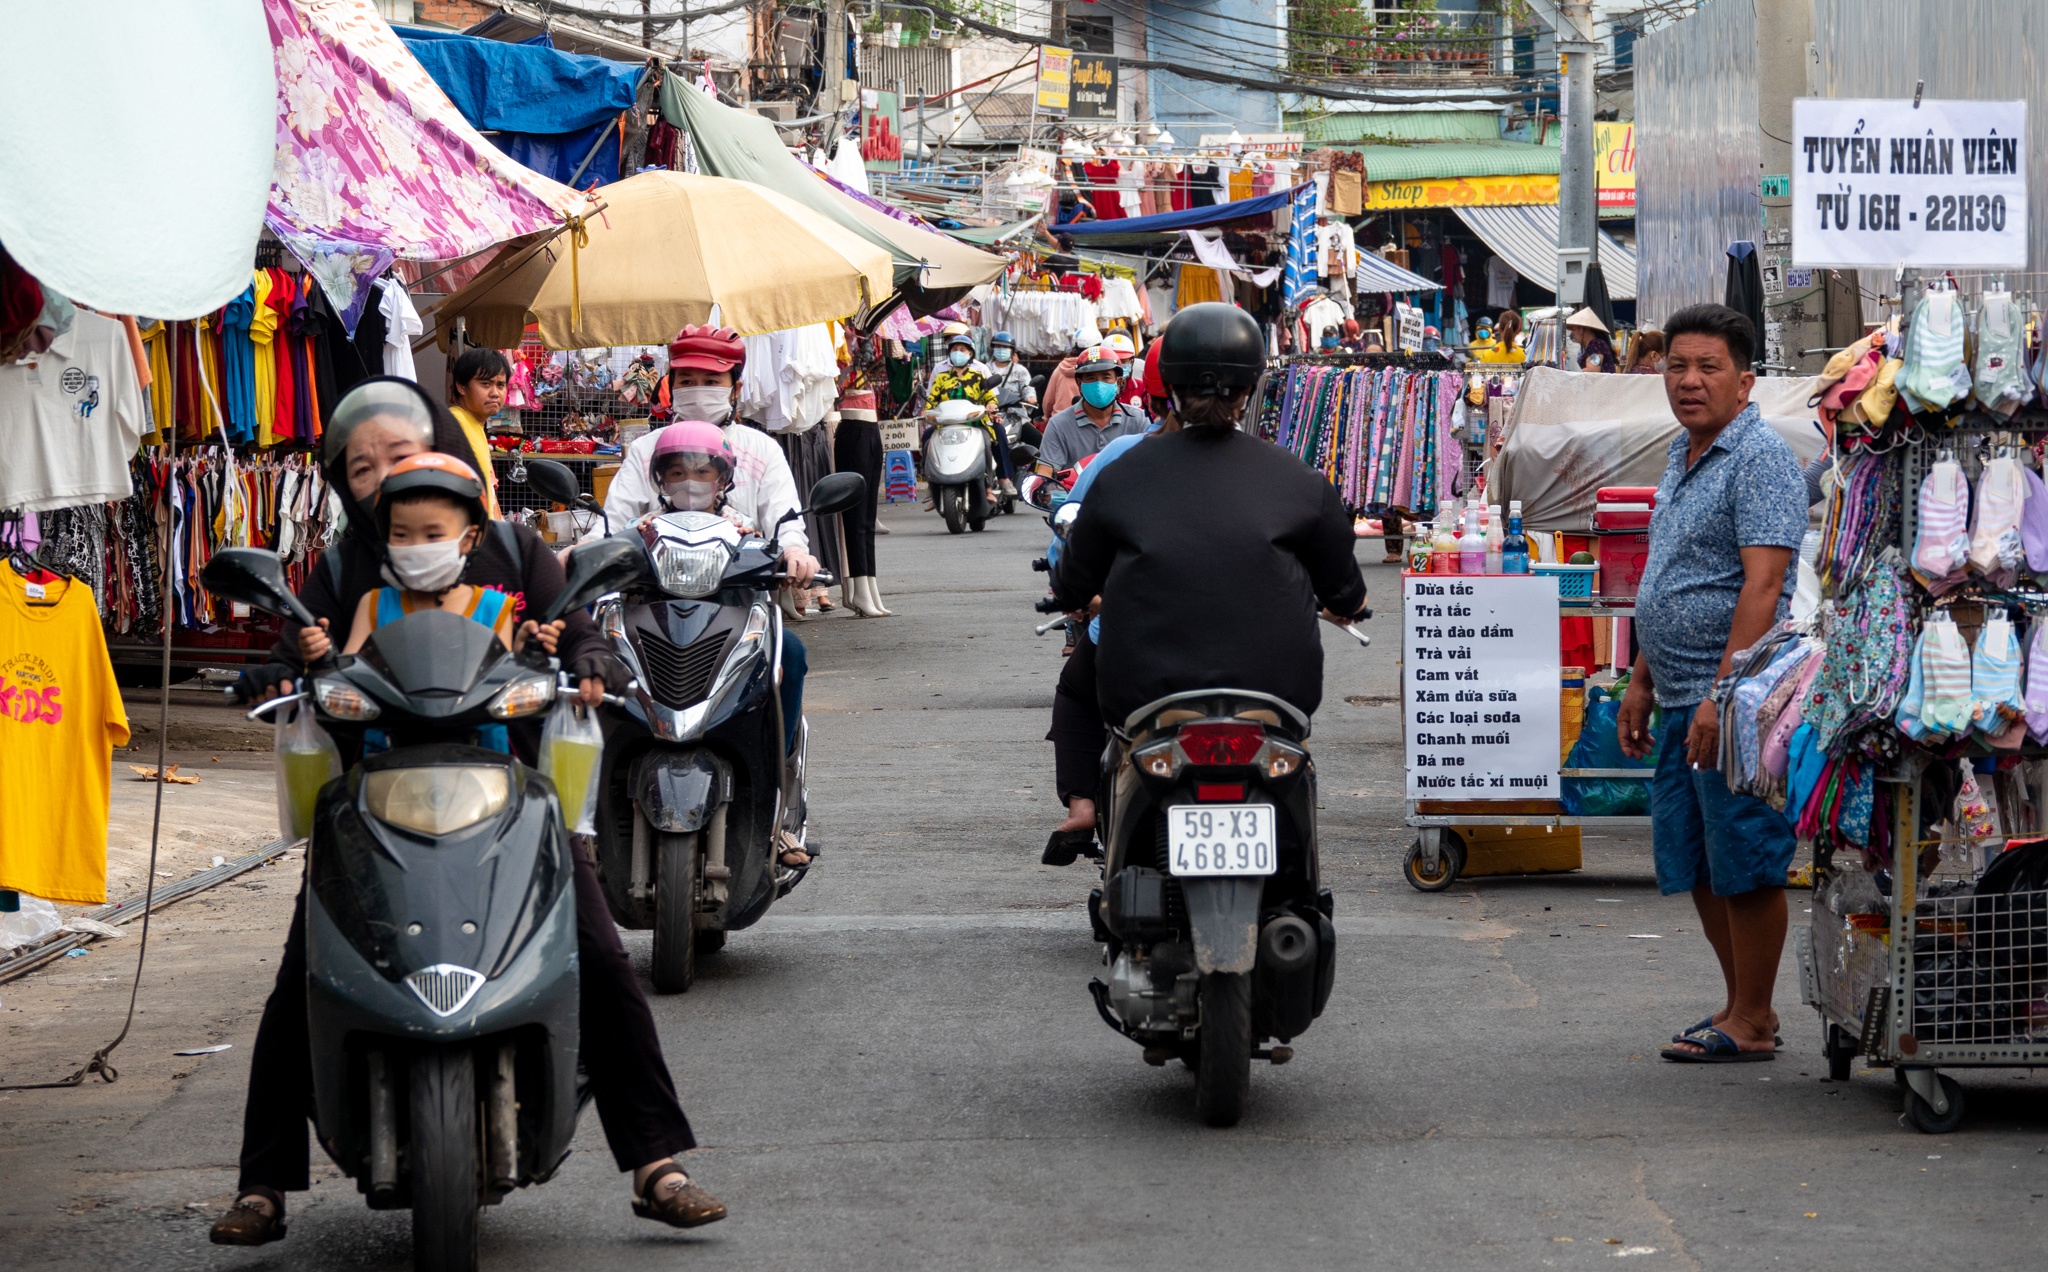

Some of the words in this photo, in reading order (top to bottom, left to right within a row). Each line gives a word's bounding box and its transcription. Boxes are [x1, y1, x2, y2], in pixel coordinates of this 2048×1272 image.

[1094, 61, 1112, 90] Shop
[1803, 118, 1881, 174] TUYỂN
[1890, 128, 1954, 175] NHÂN
[1962, 128, 2018, 175] VIÊN
[1381, 181, 1423, 203] Shop
[1426, 176, 1476, 203] ĐỒ
[1484, 184, 1556, 203] NAM
[1817, 183, 1852, 231] TỪ
[1859, 194, 1901, 231] 16H
[1925, 194, 2006, 232] 22H30
[905, 420, 917, 428] NỮ
[892, 431, 905, 439] ĐÔI
[1411, 554, 1429, 572] C2
[1415, 583, 1445, 596] Dừa
[1450, 581, 1474, 596] tắc
[1415, 604, 1442, 617] Trà
[1447, 602, 1471, 617] tắc
[1415, 626, 1442, 638] Trà
[1447, 625, 1475, 638] đào
[1416, 647, 1443, 660] Trà
[1447, 645, 1471, 660] vải
[1416, 669, 1449, 681] Cam
[1455, 666, 1479, 681] vắt
[1416, 690, 1449, 702] Xâm
[1455, 690, 1483, 702] dứa
[1488, 689, 1517, 702] sữa
[1416, 711, 1444, 724] Các
[1449, 711, 1478, 726] loại
[1483, 711, 1521, 724] sođa
[1417, 733, 1466, 745] Chanh
[1471, 730, 1510, 745] muối
[1417, 754, 1436, 767] Đá
[1442, 757, 1465, 767] me
[1417, 774, 1456, 788] Nước
[1460, 773, 1484, 788] tắc
[1489, 775, 1504, 787] xí
[1509, 775, 1548, 789] muội
[1185, 811, 1258, 839] 59-X3
[1177, 842, 1268, 871] 468.90
